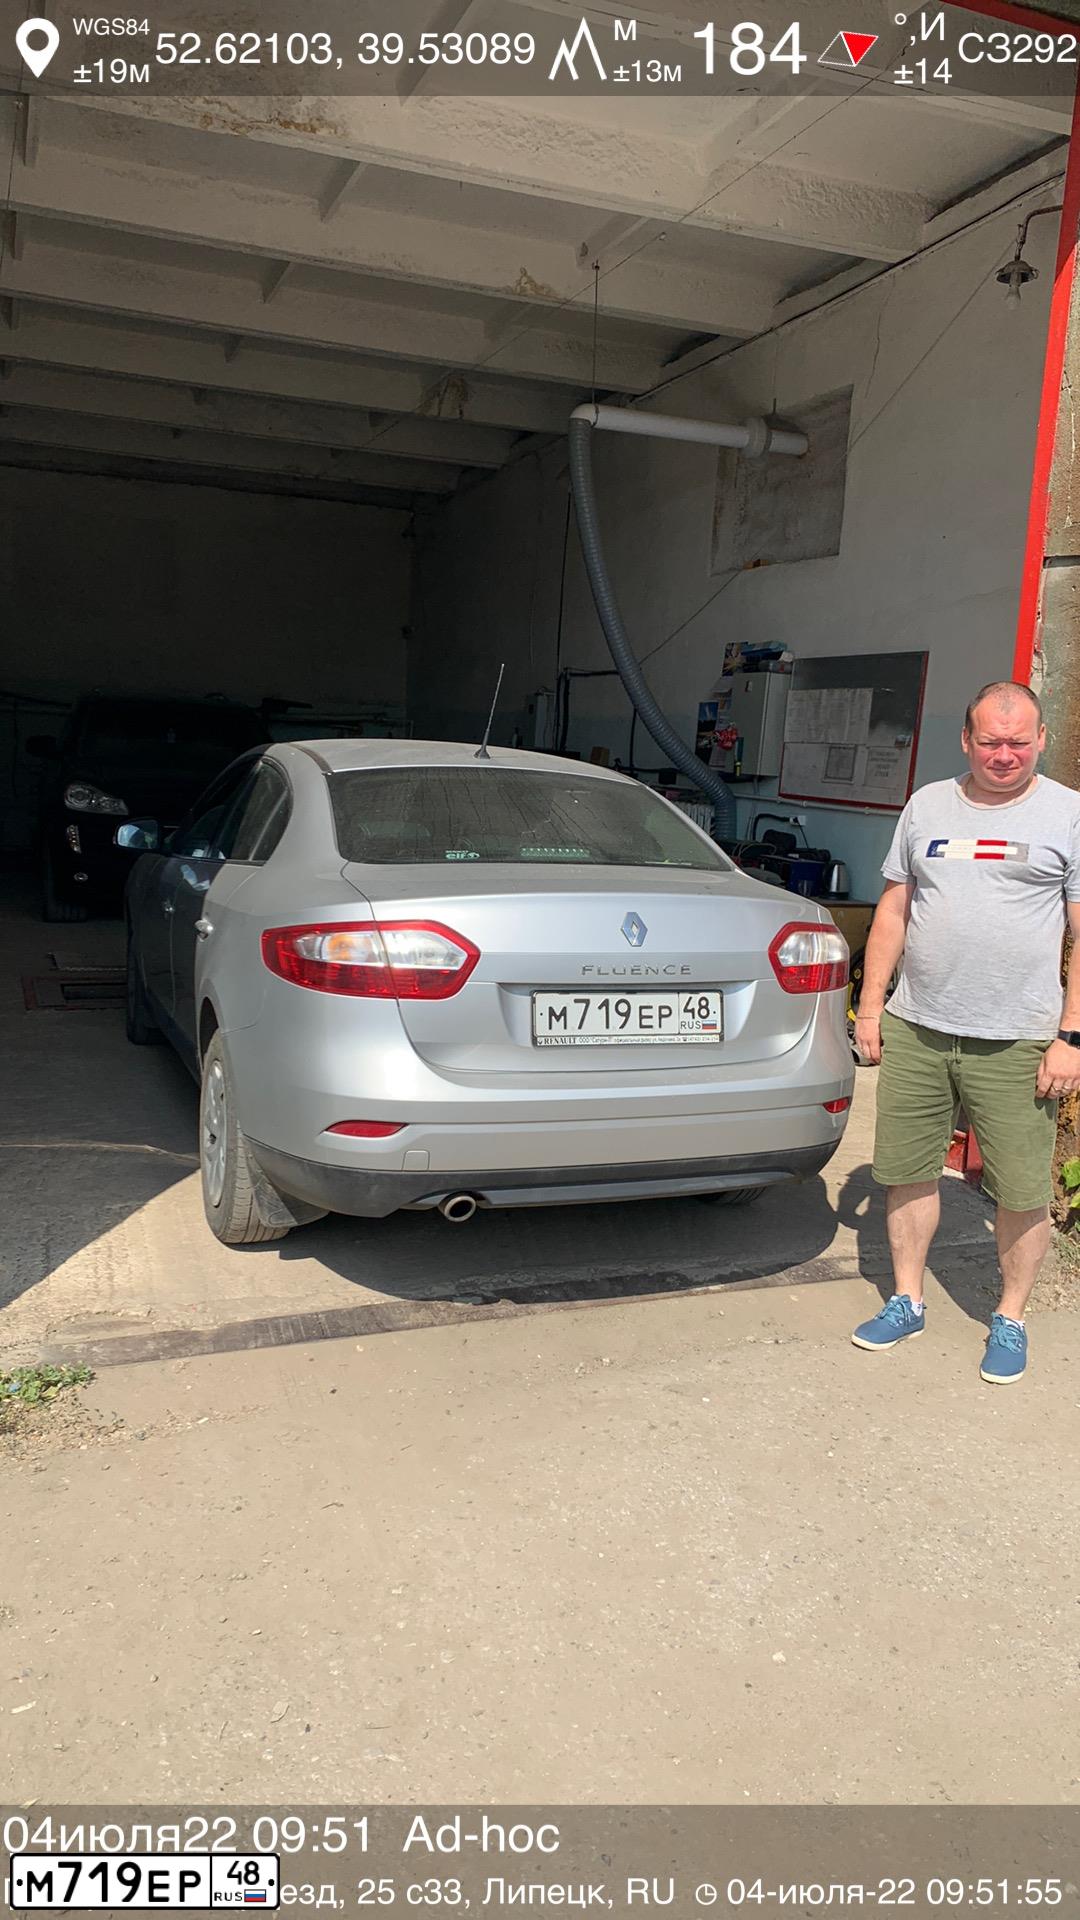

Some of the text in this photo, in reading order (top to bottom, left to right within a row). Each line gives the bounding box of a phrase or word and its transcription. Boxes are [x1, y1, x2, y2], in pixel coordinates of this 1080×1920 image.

[581, 964, 692, 976] FLUENCE
[548, 996, 711, 1030] М719ЕР 48
[680, 1020, 702, 1030] RUS
[543, 1036, 577, 1045] RENAULT
